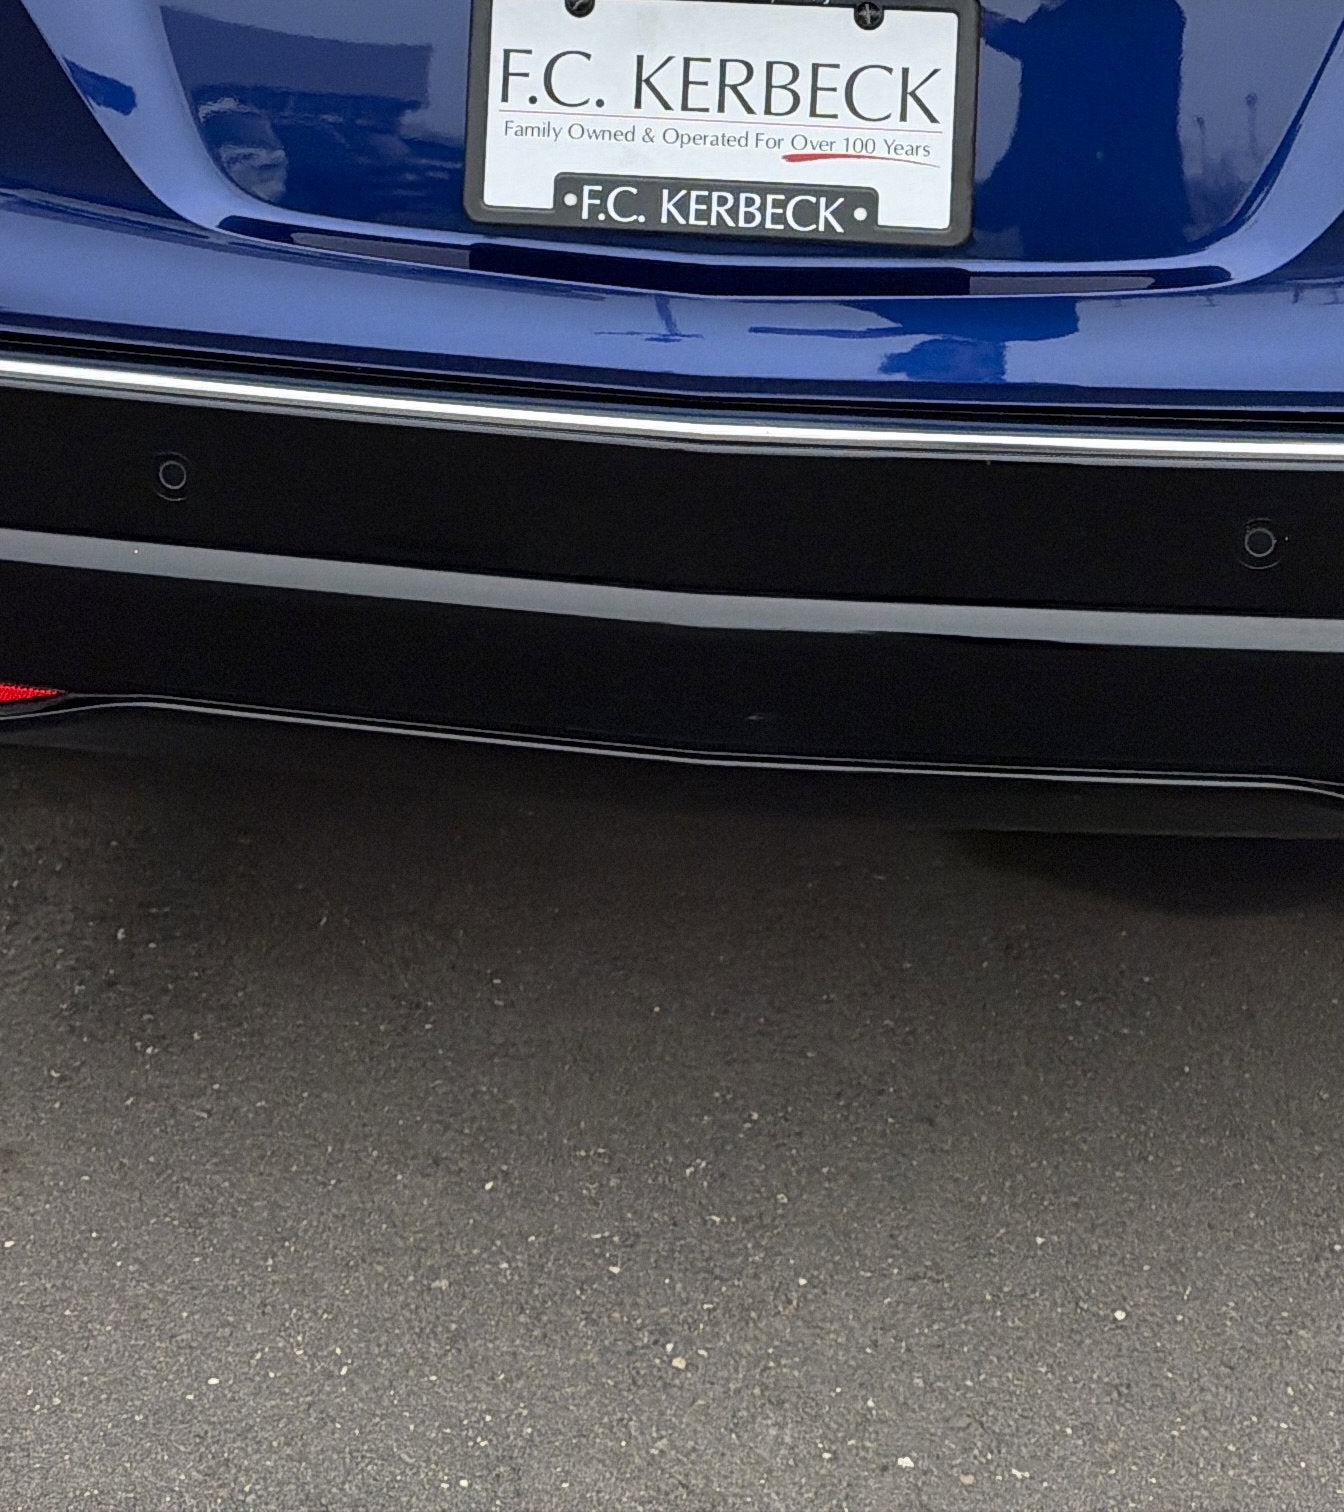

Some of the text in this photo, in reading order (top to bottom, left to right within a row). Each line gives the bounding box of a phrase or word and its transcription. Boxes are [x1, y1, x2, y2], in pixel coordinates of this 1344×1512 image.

[500, 48, 943, 124] F.C. KERBECK
[504, 120, 932, 158] Family Owned & Operated For Over 100 Years
[580, 185, 846, 233] F.C. KERBECK
